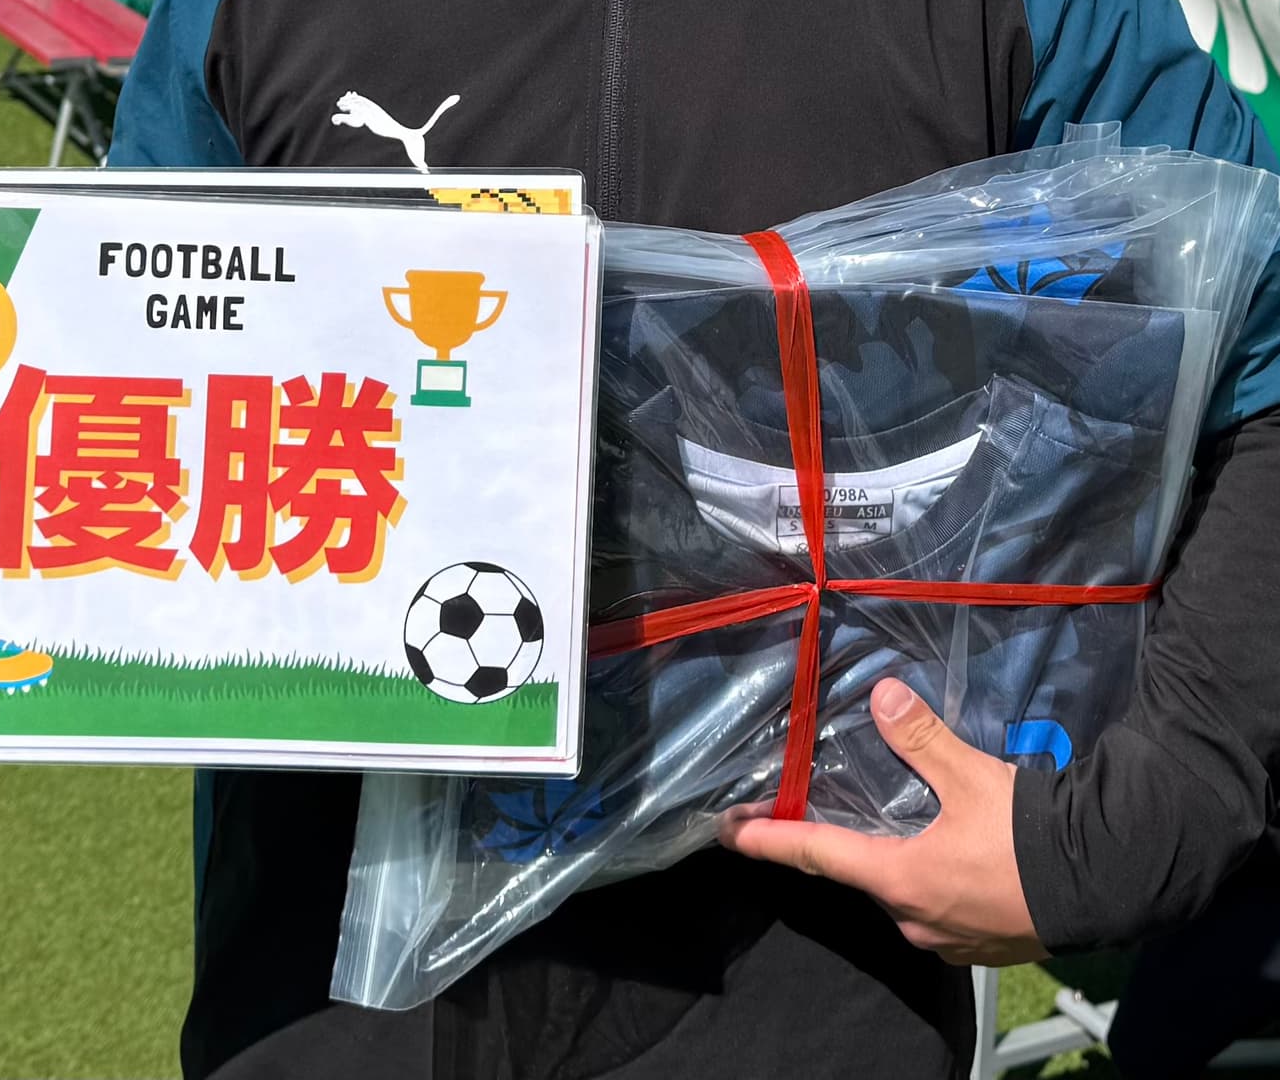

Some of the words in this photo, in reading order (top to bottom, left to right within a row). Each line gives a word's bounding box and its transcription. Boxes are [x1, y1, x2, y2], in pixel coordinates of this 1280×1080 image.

[98, 242, 297, 282] FOOTBALL
[145, 295, 245, 332] GAME
[856, 505, 887, 518] ASIA
[790, 520, 798, 531] S
[863, 521, 877, 531] M
